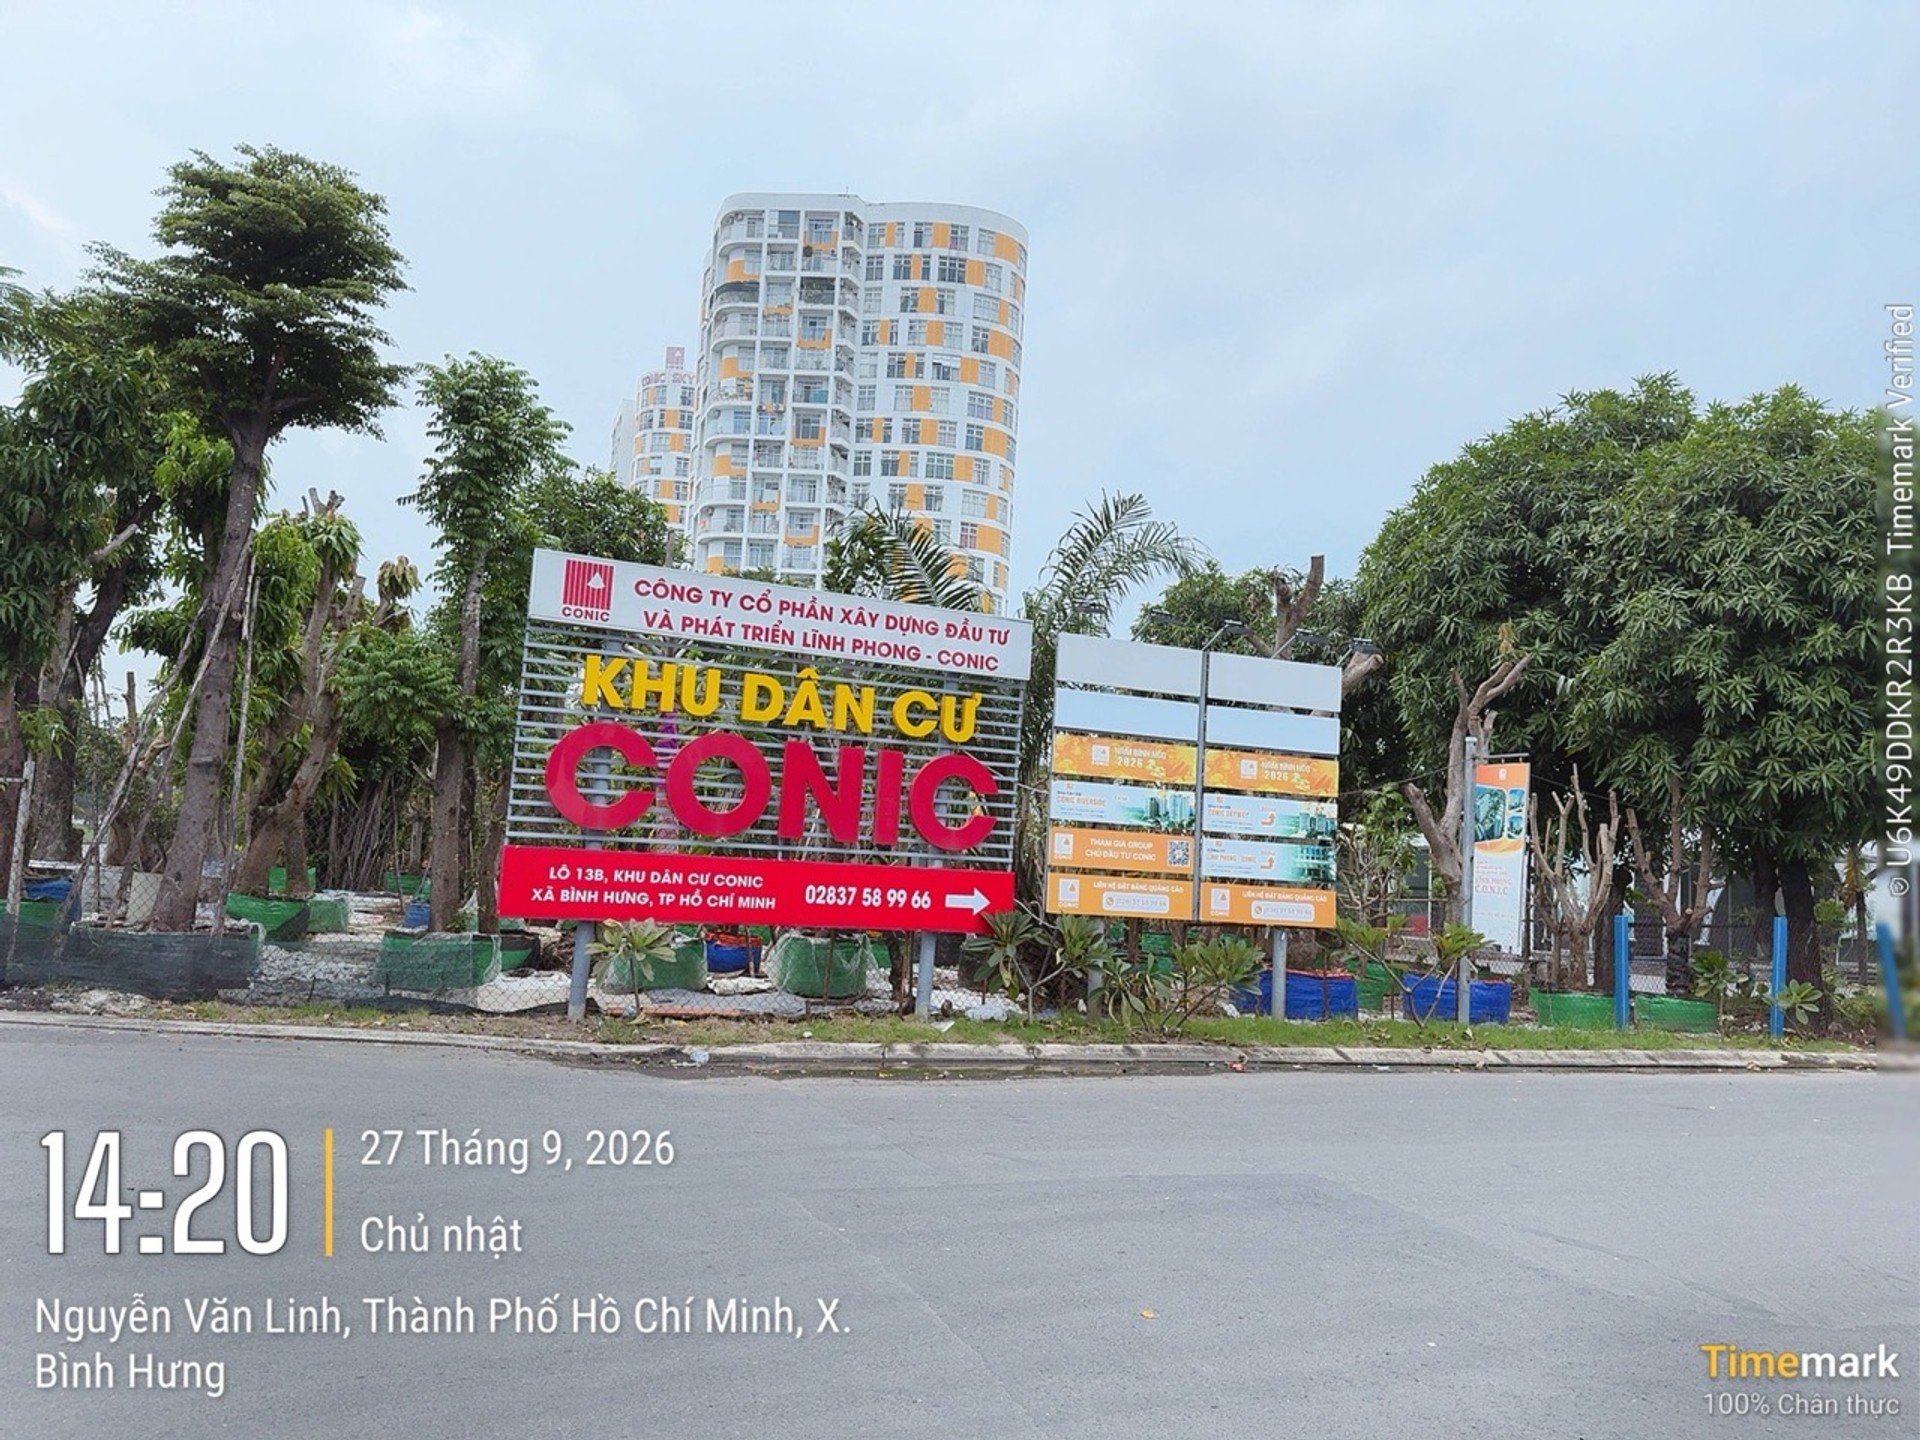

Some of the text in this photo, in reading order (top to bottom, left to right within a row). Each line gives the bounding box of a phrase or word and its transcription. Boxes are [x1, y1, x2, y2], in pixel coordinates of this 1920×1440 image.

[561, 606, 610, 622] CONIC
[635, 578, 1010, 645] CÔNG TY CỔ PHẦN XÂY DỰNG ĐẦU TƯ
[643, 609, 673, 630] VÀ
[681, 613, 736, 638] PHÁT
[741, 620, 795, 646] TRIỂN
[802, 629, 845, 651] LĨNH
[852, 638, 921, 662] PHONG
[937, 650, 999, 671] CONIC
[581, 654, 983, 744] KHU DÂN CƯ
[1117, 757, 1143, 768] 2026
[545, 720, 999, 851] CONIC
[1264, 770, 1288, 781] 2026
[1089, 838, 1153, 850] THAM GIA GROUP
[1133, 852, 1156, 861] CONIC
[549, 864, 764, 888] LÔ 13B, KHU DÂN CƯ CONIC
[531, 885, 776, 910] XÃ BÌNH HƯNG, TP HỒ CHÍ MINH
[805, 884, 931, 909] 02837 58 99 66
